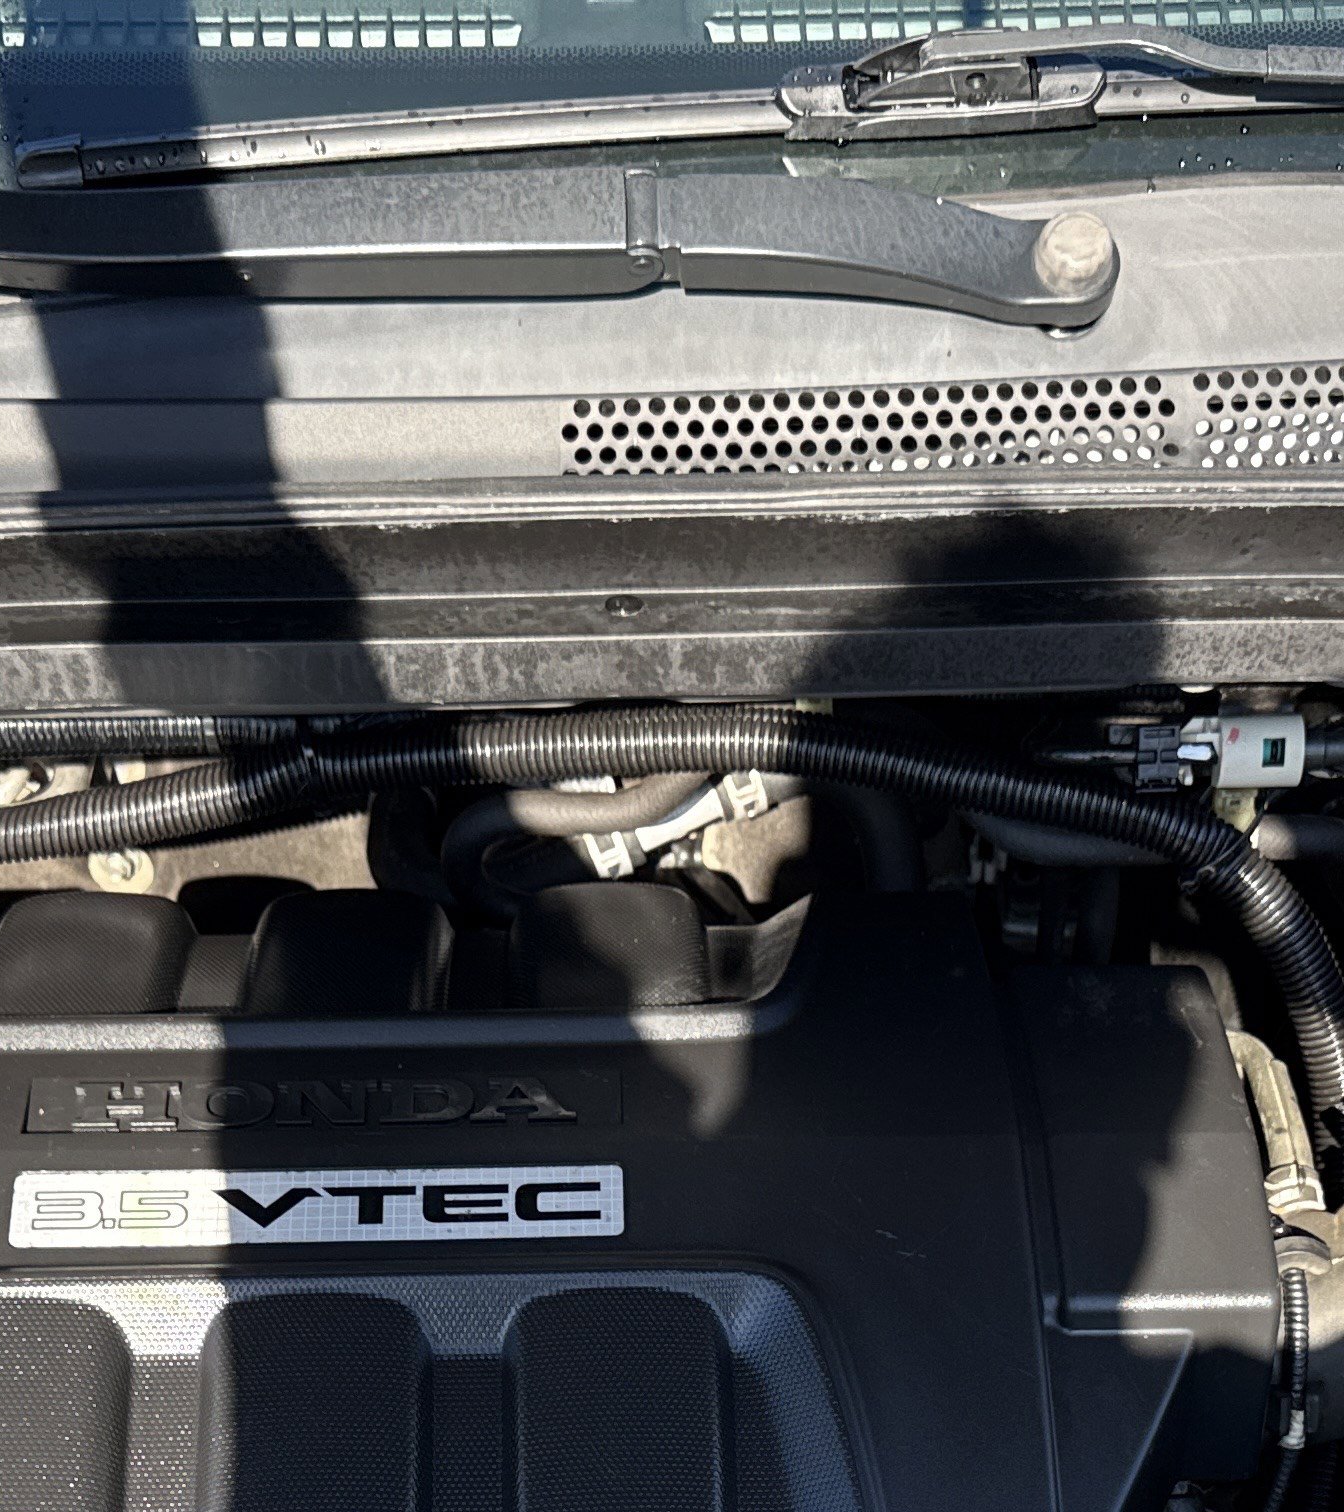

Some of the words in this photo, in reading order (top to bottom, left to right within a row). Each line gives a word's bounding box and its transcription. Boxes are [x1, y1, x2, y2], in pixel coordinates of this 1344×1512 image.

[71, 1078, 577, 1133] HONDA
[31, 1188, 189, 1230] 3.5
[214, 1182, 602, 1229] VTEC
